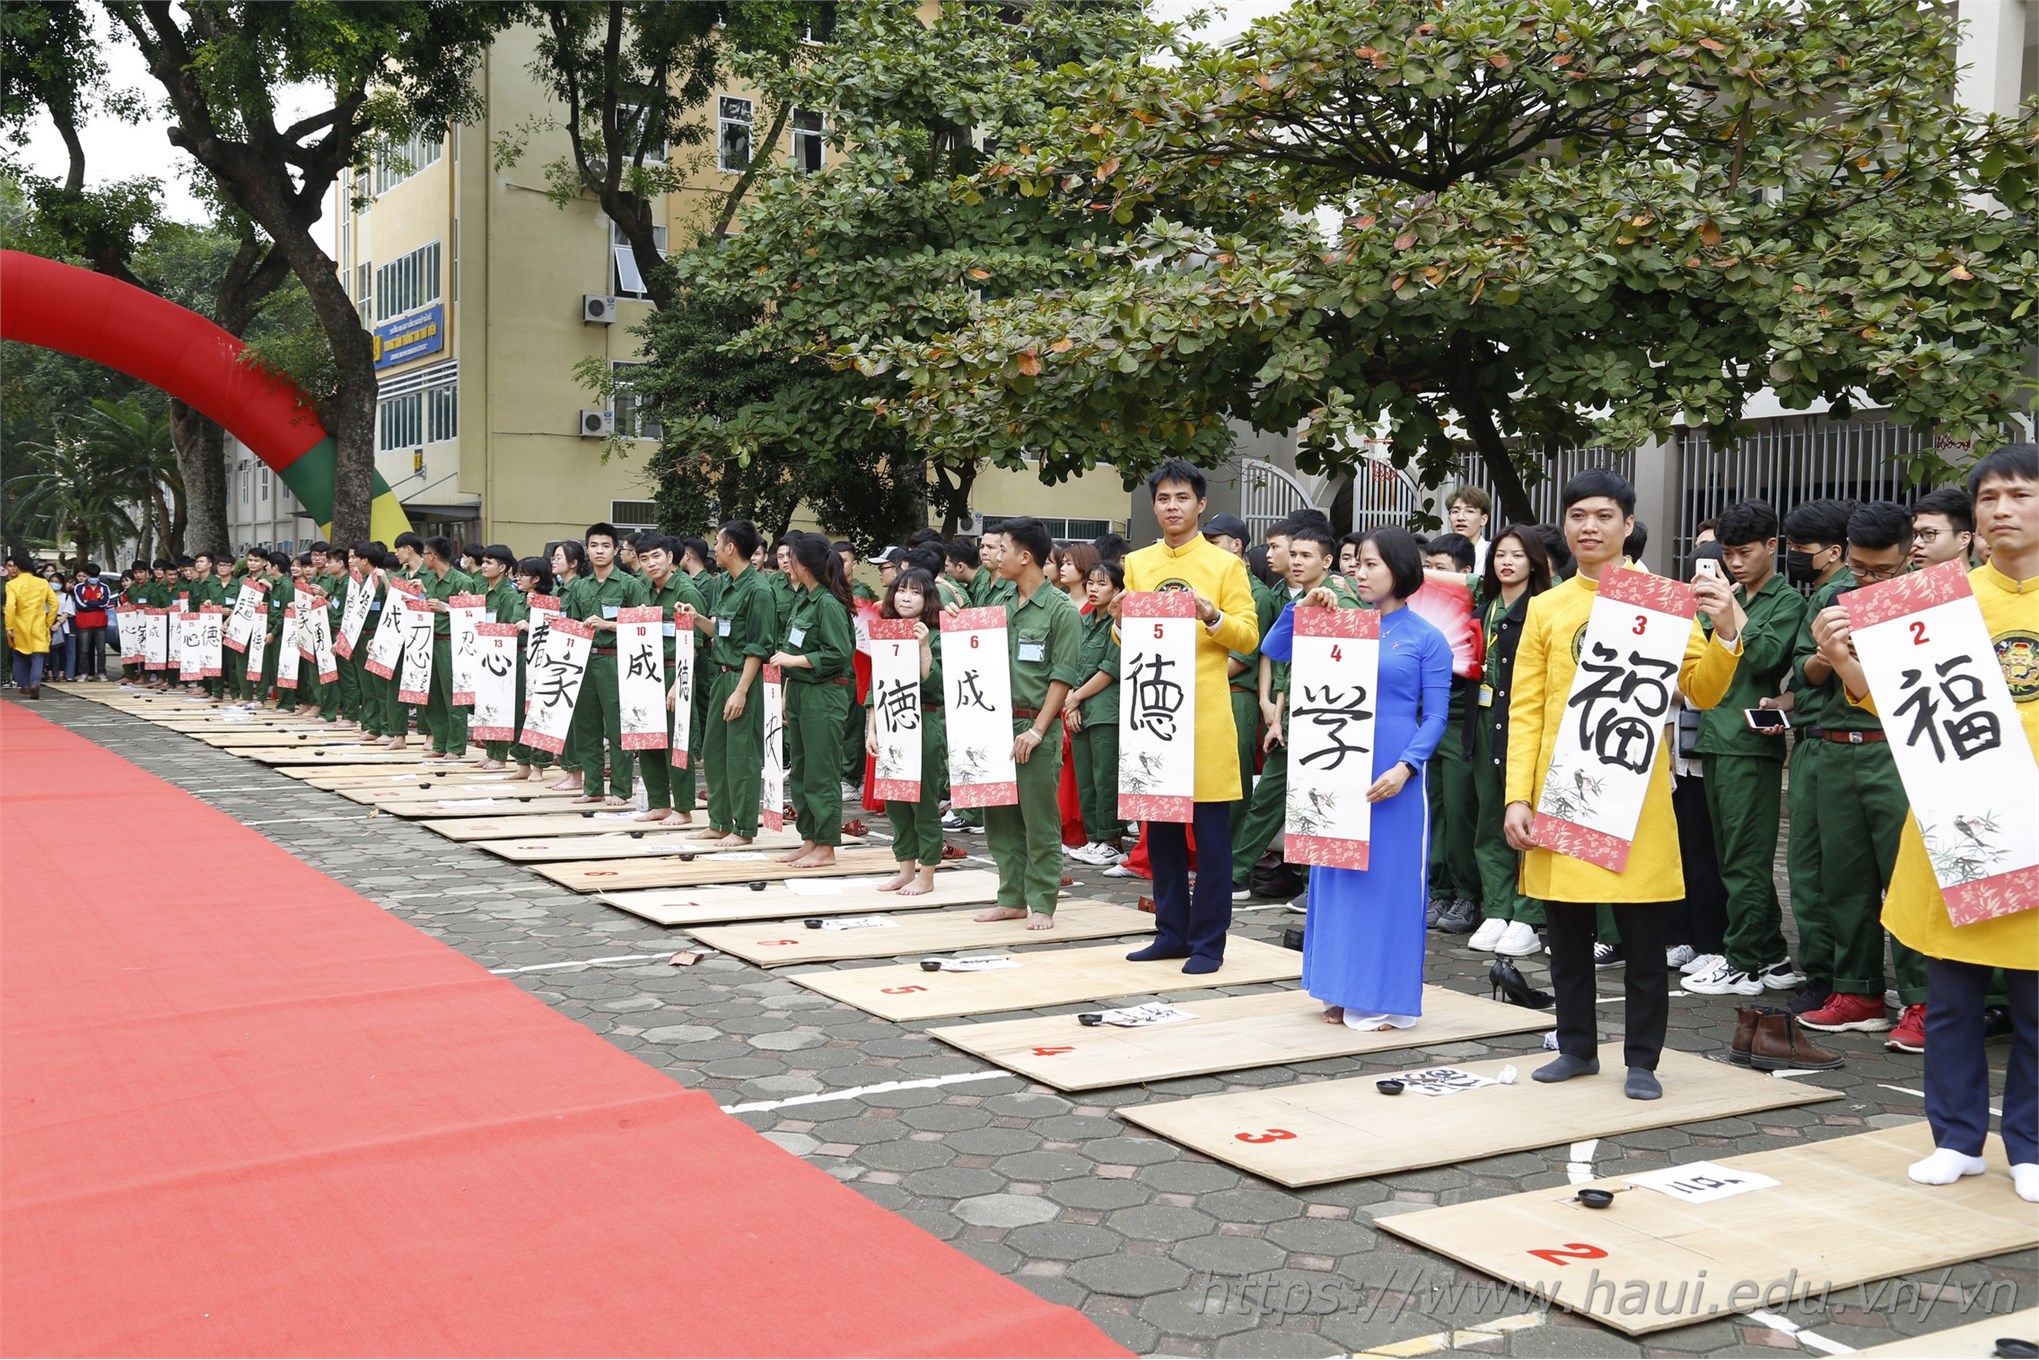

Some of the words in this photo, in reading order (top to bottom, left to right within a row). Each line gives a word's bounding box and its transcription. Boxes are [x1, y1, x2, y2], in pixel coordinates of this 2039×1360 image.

[382, 604, 403, 634] 成
[417, 613, 424, 621] 15
[465, 610, 473, 618] 14
[636, 626, 646, 637] 10
[1154, 624, 1164, 639] 5
[1632, 615, 1648, 635] 3
[1909, 621, 1930, 646] 2
[458, 630, 477, 657] 忍
[494, 639, 503, 648] 13
[566, 637, 575, 648] 11
[892, 644, 899, 656] 7
[970, 635, 979, 649] 6
[1330, 645, 1342, 662] 4
[481, 653, 512, 677] 心
[626, 643, 662, 682] 成
[956, 670, 996, 712] 成
[1568, 641, 1679, 775] 福
[1892, 654, 2003, 764] 福
[881, 984, 928, 995] 5
[1032, 1045, 1077, 1057] 4
[1234, 1128, 1298, 1145] 3
[1527, 1242, 1610, 1268] 2
